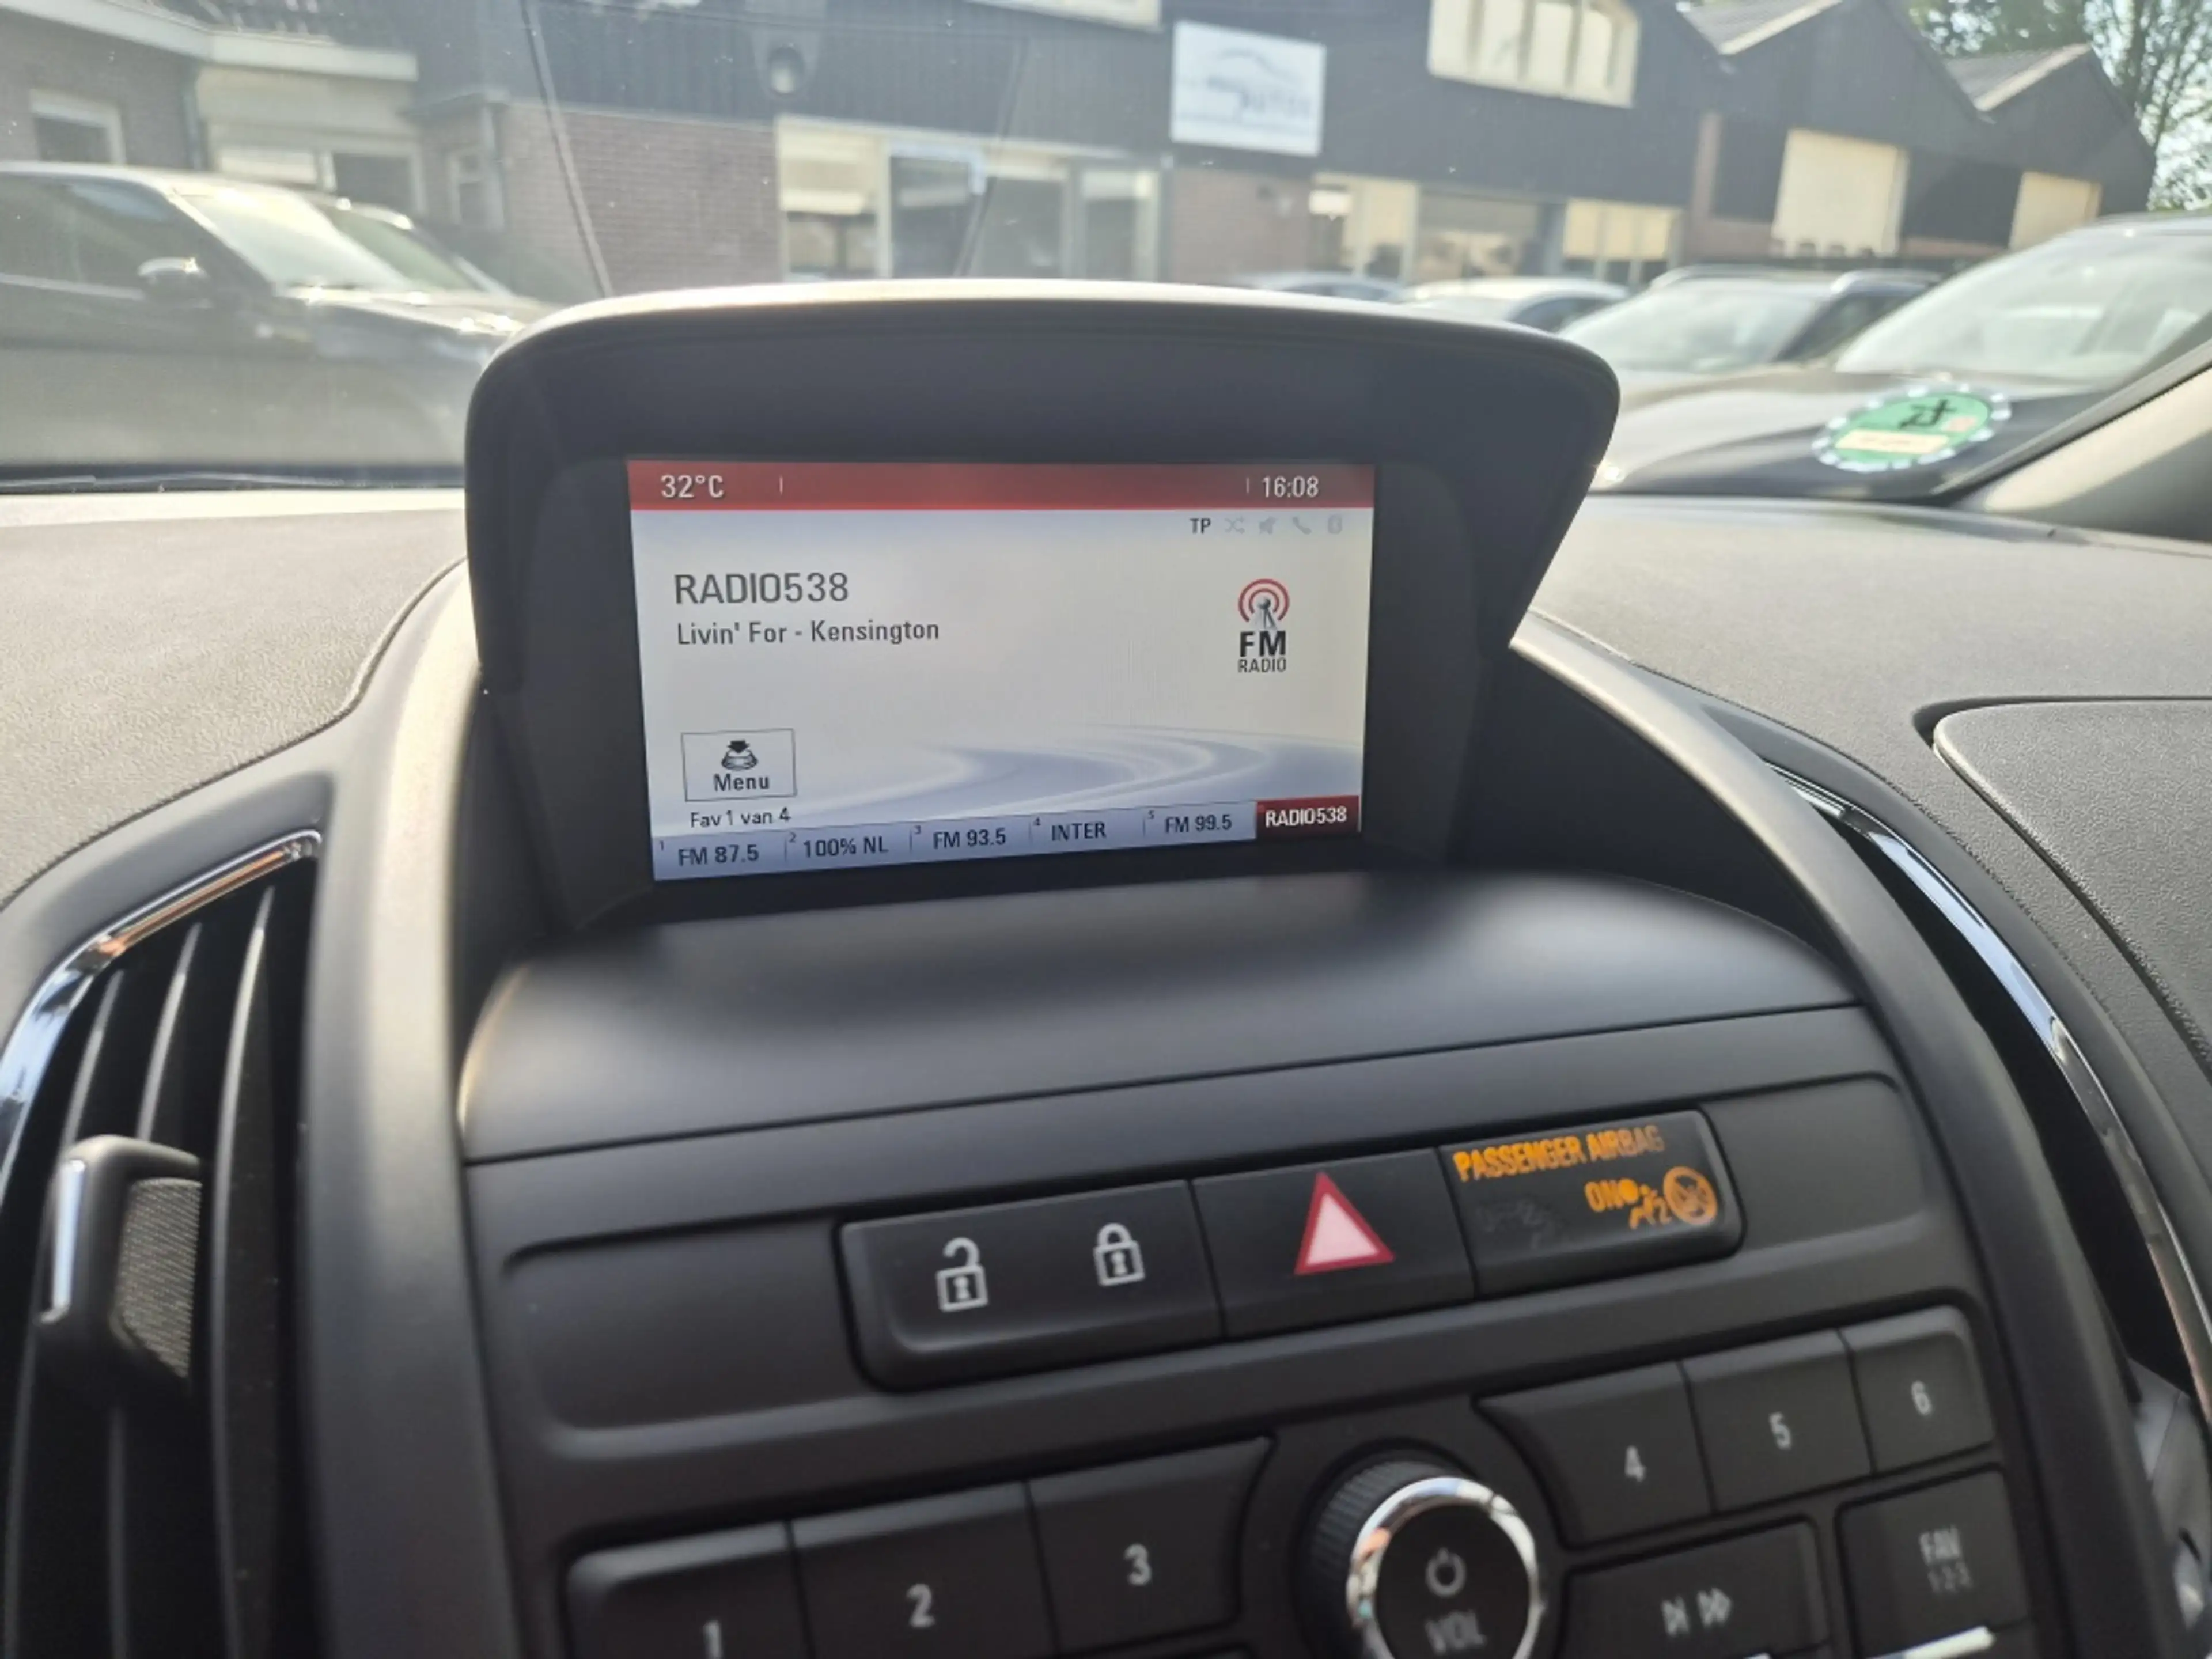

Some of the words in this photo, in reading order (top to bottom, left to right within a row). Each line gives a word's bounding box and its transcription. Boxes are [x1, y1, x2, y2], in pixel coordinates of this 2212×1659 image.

[660, 474, 725, 498] 32°C
[1262, 475, 1319, 498] 16:08
[1190, 518, 1211, 534] TP
[674, 571, 849, 604] RADIO538
[677, 622, 740, 645] Livin'
[749, 622, 787, 643] For
[810, 619, 940, 644] Kensington
[1239, 630, 1287, 657] FM
[1237, 657, 1287, 673] RADIO
[713, 774, 770, 792] Menu
[690, 812, 721, 829] Fav
[728, 810, 734, 826] 1
[741, 811, 773, 825] van
[779, 807, 791, 823] 4
[1165, 816, 1190, 833] FM
[1195, 814, 1232, 832] 99.5
[1265, 806, 1347, 827] RADIO538
[914, 825, 922, 835] 3
[933, 831, 961, 849] FM
[967, 828, 1007, 847] 93.5
[1051, 821, 1107, 842] INTER
[679, 847, 708, 867] FM
[714, 843, 760, 863] 87.5
[789, 832, 796, 843] 2
[804, 838, 857, 858] 100%
[863, 835, 888, 854] NL
[1453, 1135, 1587, 1181] PASSENGER
[1585, 1124, 1665, 1161] AIRBAG
[1911, 1380, 1933, 1416] 6
[1768, 1412, 1792, 1450] 5
[1624, 1445, 1646, 1482] 4
[1919, 1525, 1961, 1566] FAV
[1124, 1543, 1152, 1585] 3
[907, 1583, 935, 1627] 2
[702, 1619, 723, 1659] 1
[1425, 1610, 1487, 1655] VOL
